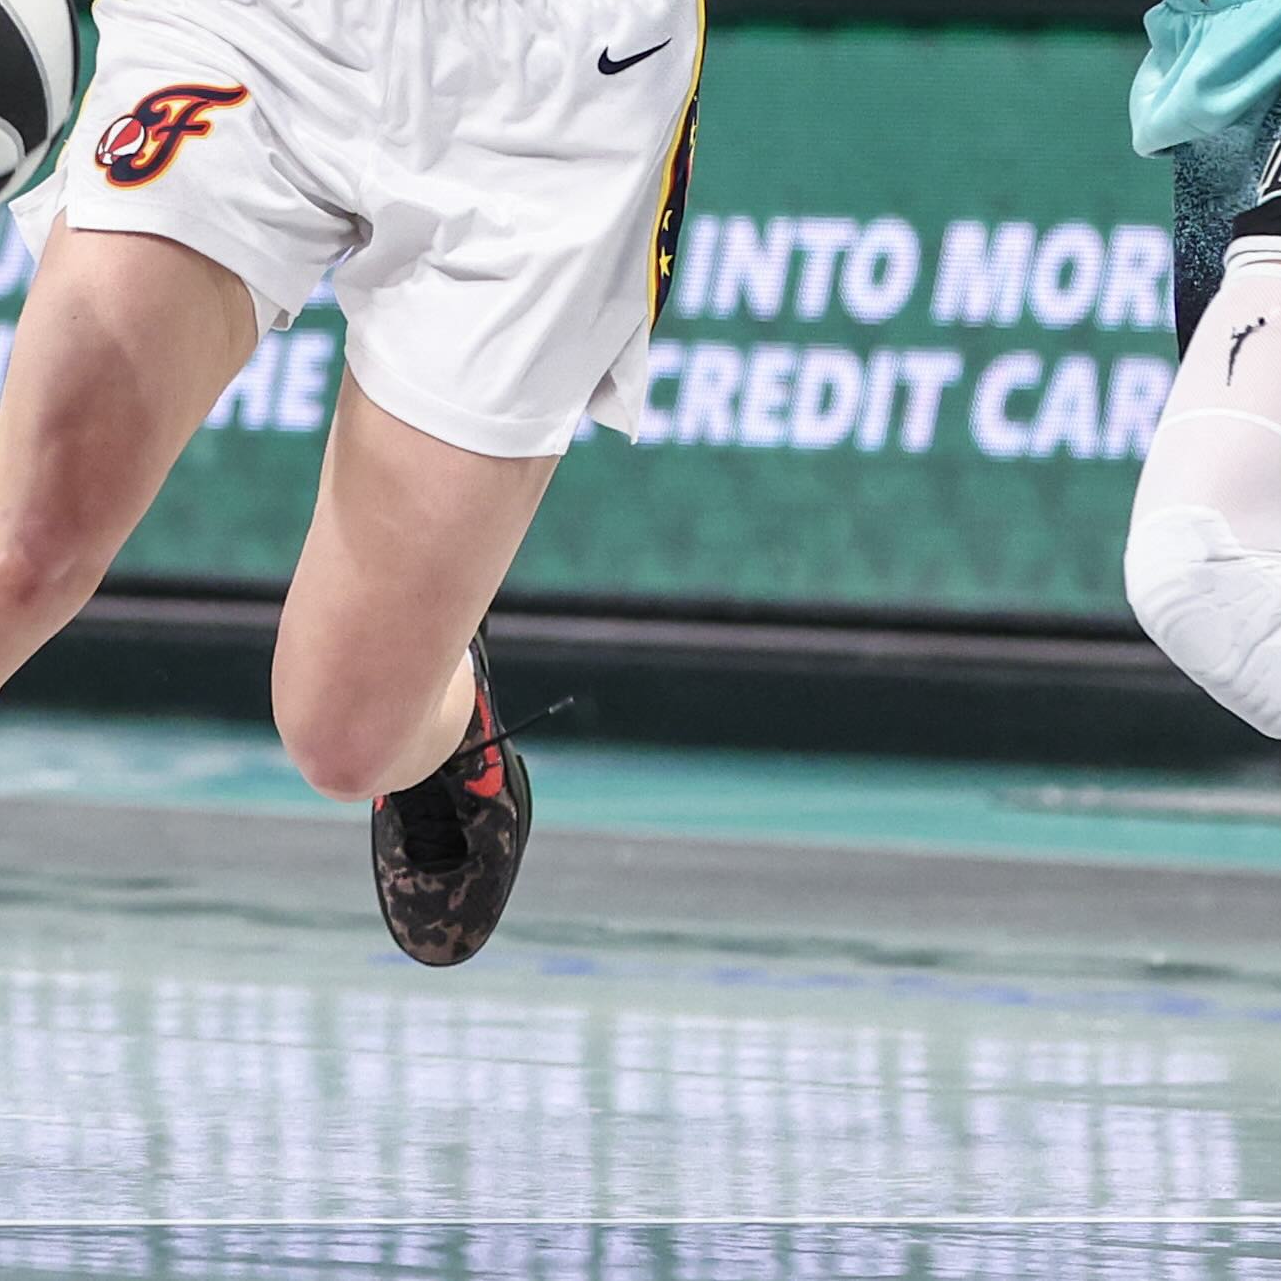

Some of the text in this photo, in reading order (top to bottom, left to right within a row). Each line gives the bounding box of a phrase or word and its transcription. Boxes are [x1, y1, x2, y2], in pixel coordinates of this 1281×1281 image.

[676, 215, 921, 325] INTO
[929, 219, 1177, 331] MOR
[636, 339, 965, 454] CREDIT
[968, 348, 1180, 461] CAR
